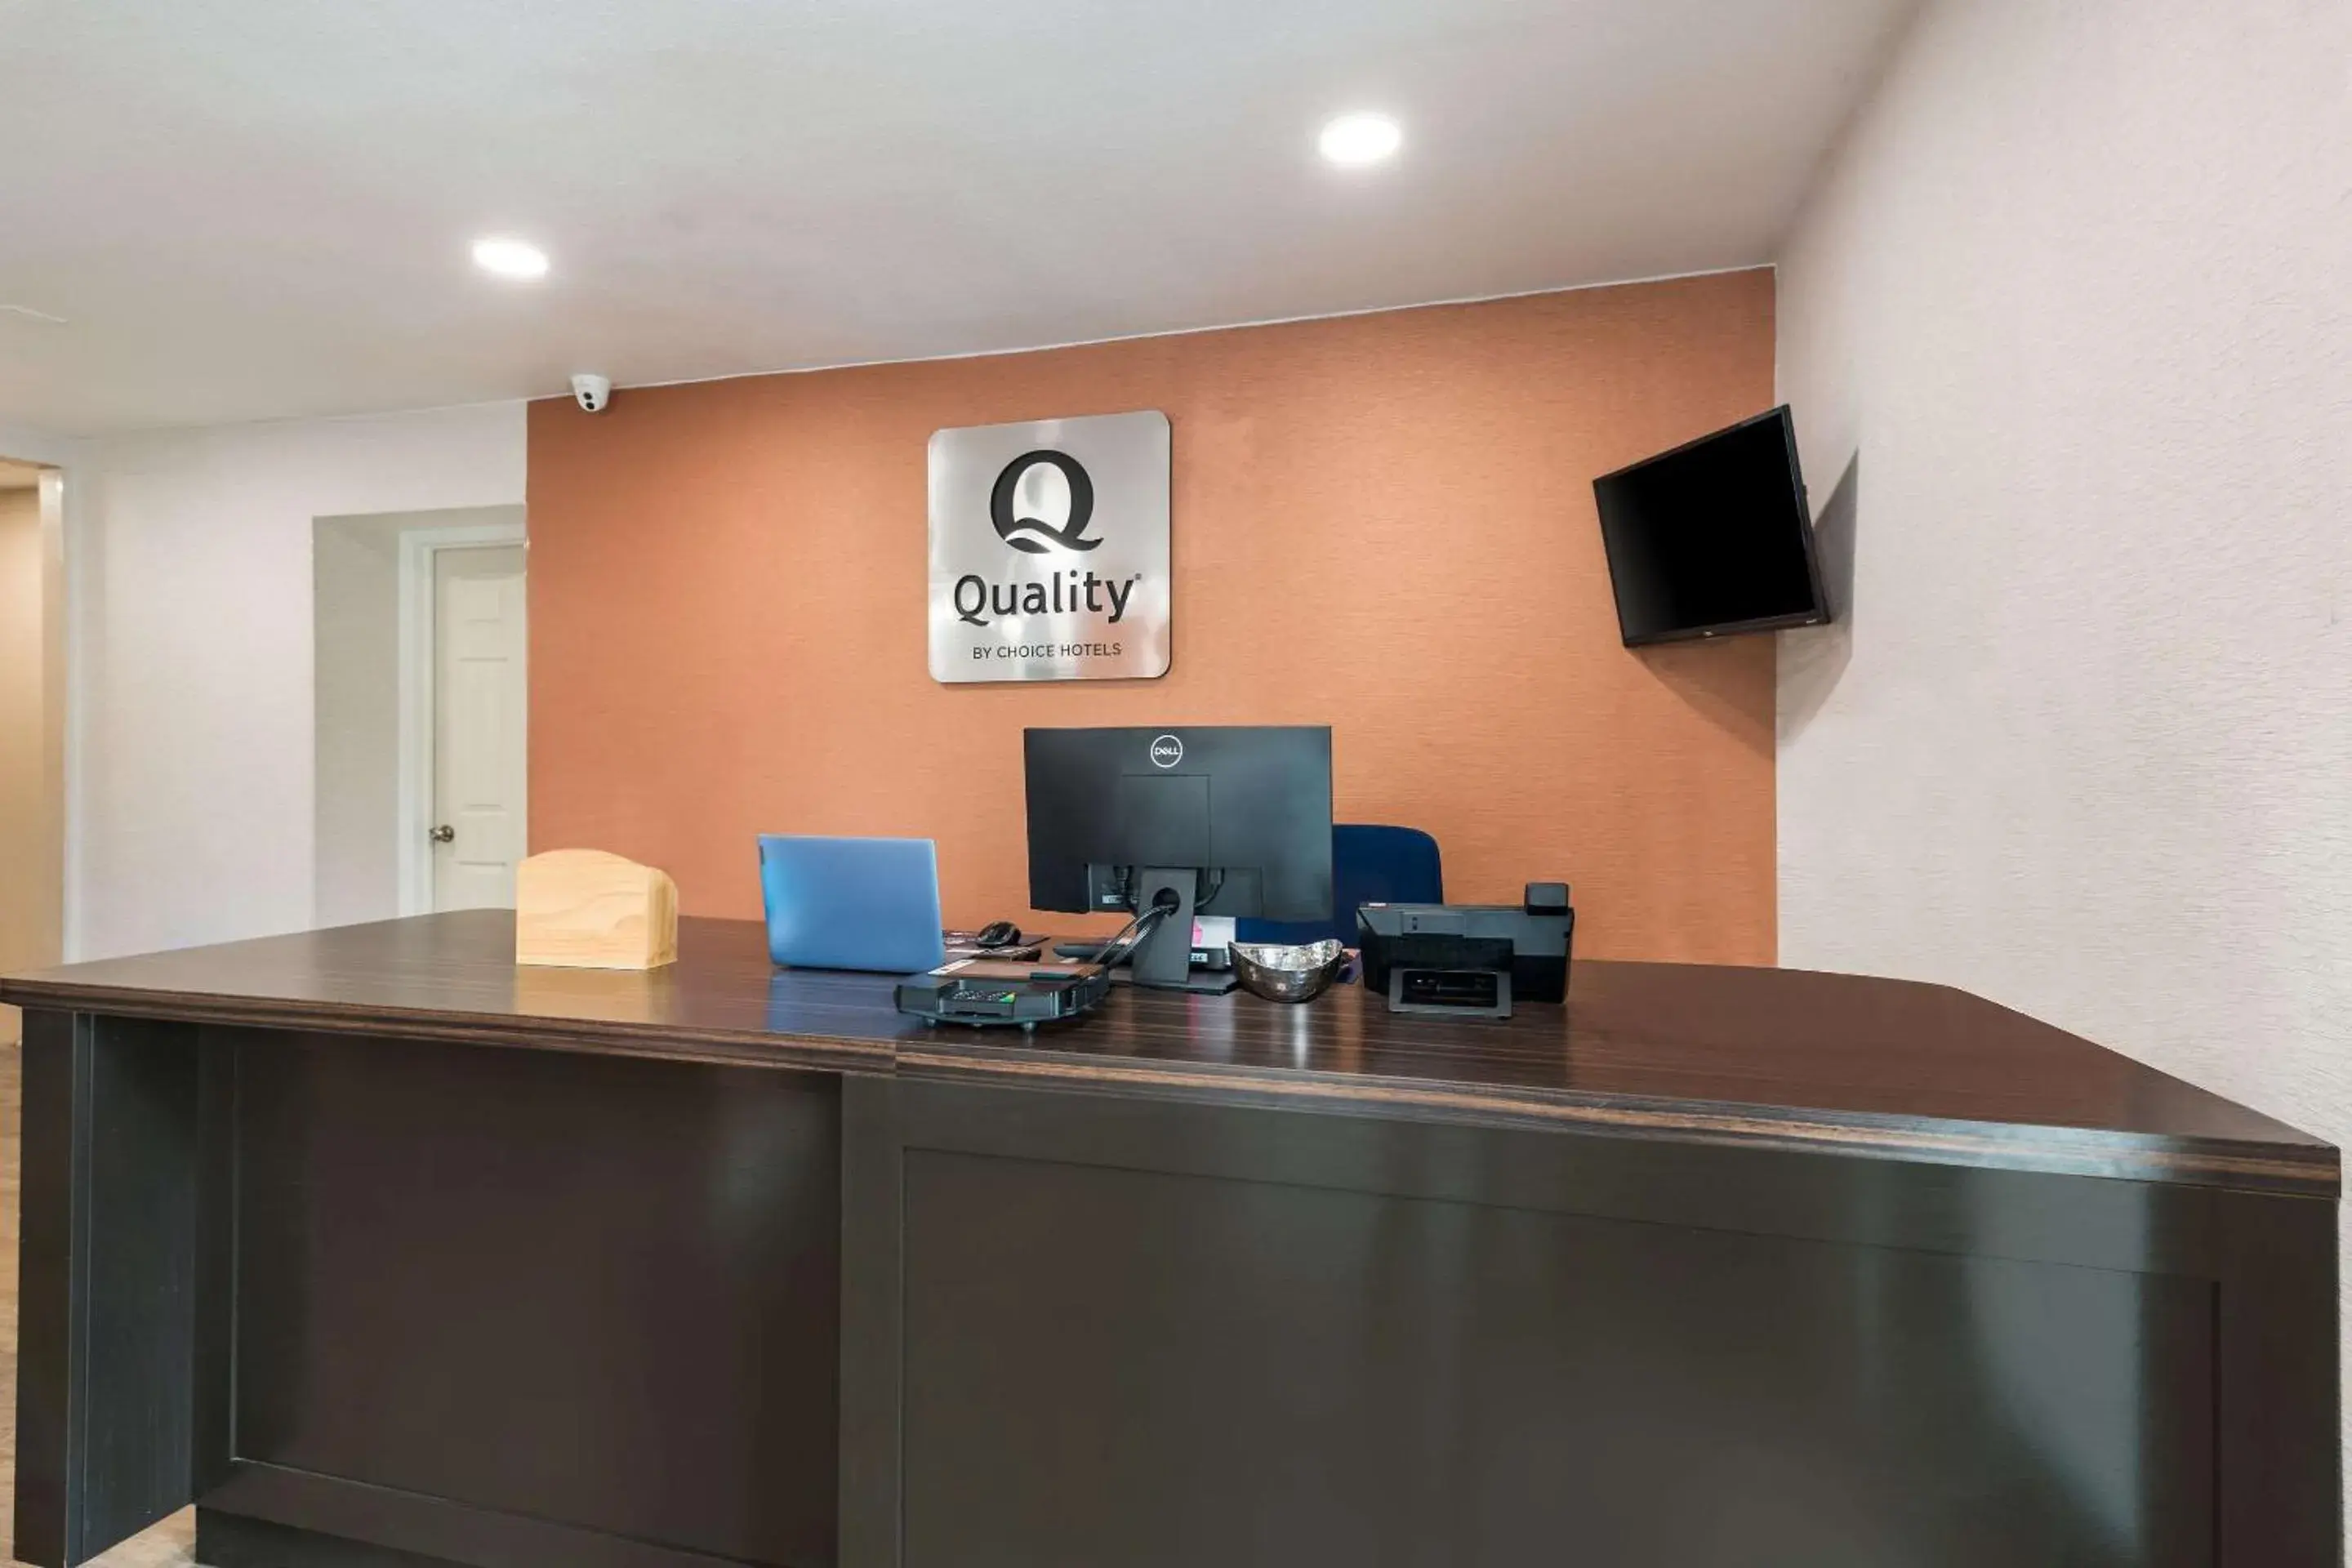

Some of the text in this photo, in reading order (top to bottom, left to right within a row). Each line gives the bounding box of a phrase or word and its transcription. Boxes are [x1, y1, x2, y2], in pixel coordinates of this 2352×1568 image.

[990, 449, 1104, 554] Q
[954, 570, 1134, 626] Quality
[973, 642, 1122, 660] BY CHOICE HOTELS
[1155, 746, 1179, 755] DELL
